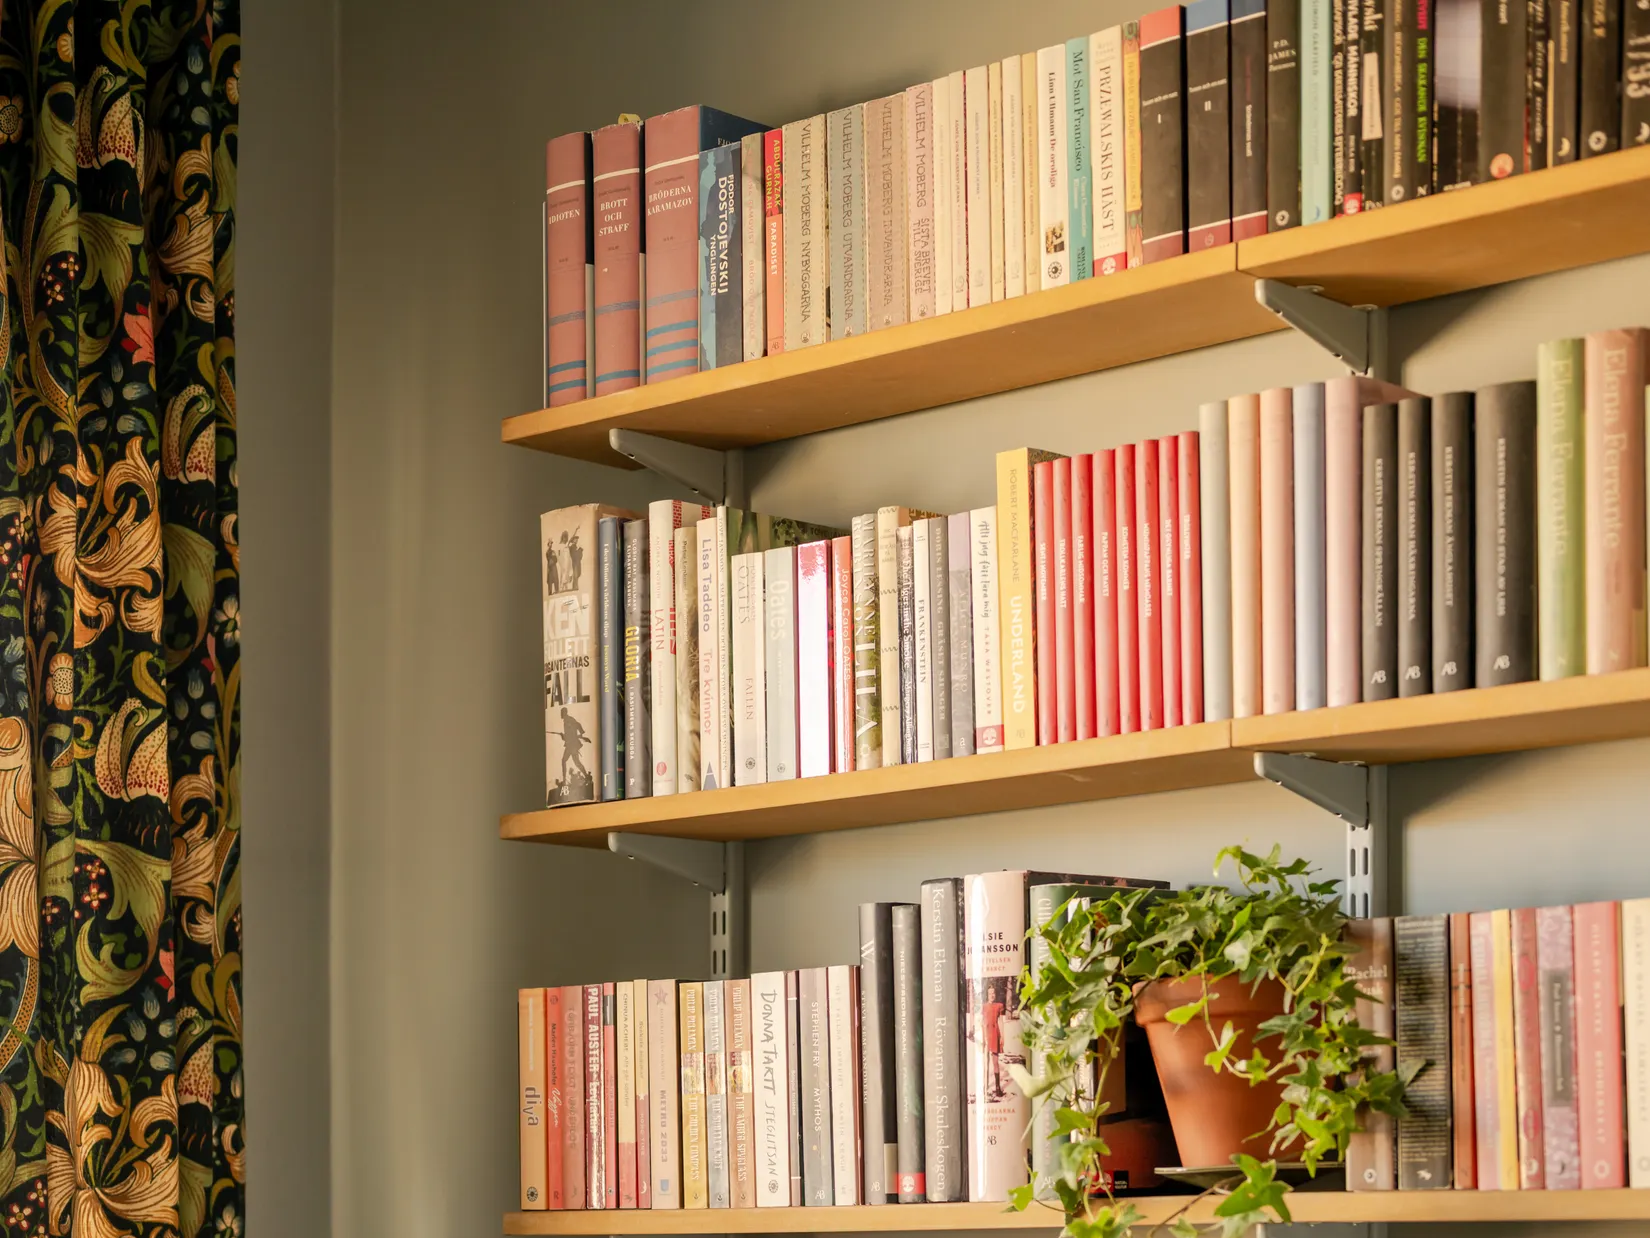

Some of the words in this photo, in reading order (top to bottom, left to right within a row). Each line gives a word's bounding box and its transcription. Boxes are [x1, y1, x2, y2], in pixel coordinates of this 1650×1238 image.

[1073, 51, 1083, 76] Mot
[1269, 49, 1297, 64] JAMES
[1312, 32, 1320, 76] GARFIELD
[1417, 38, 1428, 58] DEN
[1048, 72, 1056, 94] Linn
[1073, 79, 1084, 105] San
[1347, 45, 1360, 117] MÄNNISKOR
[882, 101, 893, 159] VILHELM
[915, 90, 925, 150] VILHELM
[1048, 96, 1057, 136] Ullmann
[1099, 65, 1113, 181] PRZEWALSKIS
[800, 123, 812, 184] VILHELM
[842, 112, 853, 170] VILHELM
[1049, 138, 1057, 151] De
[1074, 108, 1085, 171] Francisco
[765, 165, 773, 209] GURNAH
[773, 139, 781, 207] ABDULRAZAK
[882, 163, 893, 216] MOBERG
[916, 155, 926, 208] MOBERG
[1049, 153, 1057, 188] oroliga
[600, 197, 629, 211] BROTT
[647, 196, 694, 217] KARAMAZOV
[648, 185, 693, 203] BRÖDERNA
[800, 185, 811, 236] MOBERG
[843, 174, 853, 228] MOBERG
[1101, 186, 1117, 231] HÄST
[549, 208, 581, 225] IDIOTEN
[598, 223, 631, 237] STRAFF
[604, 211, 623, 223] OCH
[717, 176, 728, 294] DOSTOJEVSKIJ
[912, 222, 921, 247] TILL
[920, 218, 930, 248] SISTA
[800, 241, 811, 323] NYBYGGARNA
[843, 233, 853, 321] UTVANDRARNA
[914, 251, 922, 295] SVERIGE
[921, 251, 931, 294] BREVET
[1550, 358, 1573, 432] Elena
[1602, 347, 1627, 425] Elena
[1010, 469, 1018, 509] ROBERT
[1375, 458, 1383, 504] KERSTIN
[1408, 453, 1416, 499] KERSTIN
[1445, 447, 1453, 493] KERSTIN
[1604, 432, 1627, 549] Ferrante
[1408, 501, 1416, 538] EKMAN
[1445, 495, 1453, 533] EKMAN
[1550, 441, 1573, 555] Ferrante
[978, 521, 990, 538] Allt
[978, 541, 991, 557] jag
[1011, 512, 1020, 583] MACFARLANE
[702, 538, 712, 570] Lisa
[902, 558, 912, 579] The
[978, 560, 991, 578] fått
[1445, 536, 1454, 606] ÄNGLAHUSET
[738, 565, 750, 625] OATES
[840, 569, 849, 604] Joyce
[853, 519, 864, 637] ROBINSON
[863, 517, 876, 636] MARILYNNE
[901, 580, 912, 604] Tiger
[980, 580, 990, 598] lära
[1375, 546, 1384, 626] SPRINGKÄLLAN
[1408, 540, 1417, 621] HÄXRINGARNA
[543, 593, 590, 642] KEN
[603, 587, 611, 619] världens
[703, 573, 713, 632] Taddeo
[769, 580, 790, 640] Oates
[903, 605, 912, 614] in
[980, 601, 992, 618] mig
[602, 621, 611, 638] djup
[655, 608, 665, 650] LATIN
[904, 616, 912, 634] the
[918, 599, 926, 684] FRANKENSTEIN
[937, 621, 946, 665] GRÄSET
[603, 644, 611, 671] Jesmyn
[625, 626, 640, 682] GLORIA
[703, 648, 713, 673] Tre
[843, 645, 851, 681] OATES
[904, 635, 912, 668] Smoke
[960, 640, 968, 693] MUNRO
[1010, 595, 1025, 713] UNDERLAND
[545, 668, 590, 710] FALL
[703, 679, 714, 736] kvinnor
[745, 676, 754, 720] FALLEN
[855, 640, 878, 738] LILA
[933, 887, 945, 943] Kerstin
[860, 939, 875, 969] W.
[933, 948, 946, 1002] Ekman
[587, 987, 599, 1019] PAUL
[687, 989, 696, 1013] PHILIP
[709, 988, 718, 1013] PHILIP
[733, 987, 742, 1011] PHILIP
[760, 989, 778, 1043] DONNA
[568, 1007, 577, 1057] TORBJÖRN
[687, 1015, 697, 1051] PULLMAN
[710, 1016, 720, 1050] PULLMAN
[734, 1013, 744, 1049] PULLMAN
[810, 1001, 819, 1047] STEPHEN
[588, 1024, 600, 1073] AUSTER
[763, 1044, 778, 1095] TARTT
[934, 1016, 947, 1080] Rövarna
[522, 1086, 542, 1126] diva
[568, 1096, 577, 1149] UNDERDOG
[689, 1096, 698, 1112] THE
[712, 1098, 721, 1113] THE
[735, 1095, 745, 1111] THE
[813, 1087, 822, 1132] MYTHOS
[689, 1114, 699, 1143] GOLDEN
[736, 1114, 745, 1141] AMBER
[764, 1100, 779, 1176] STEGLITSAN
[931, 1095, 949, 1191] Skuleskogen
[690, 1145, 700, 1180] COMPASS
[738, 1143, 747, 1182] SPYGLASS
